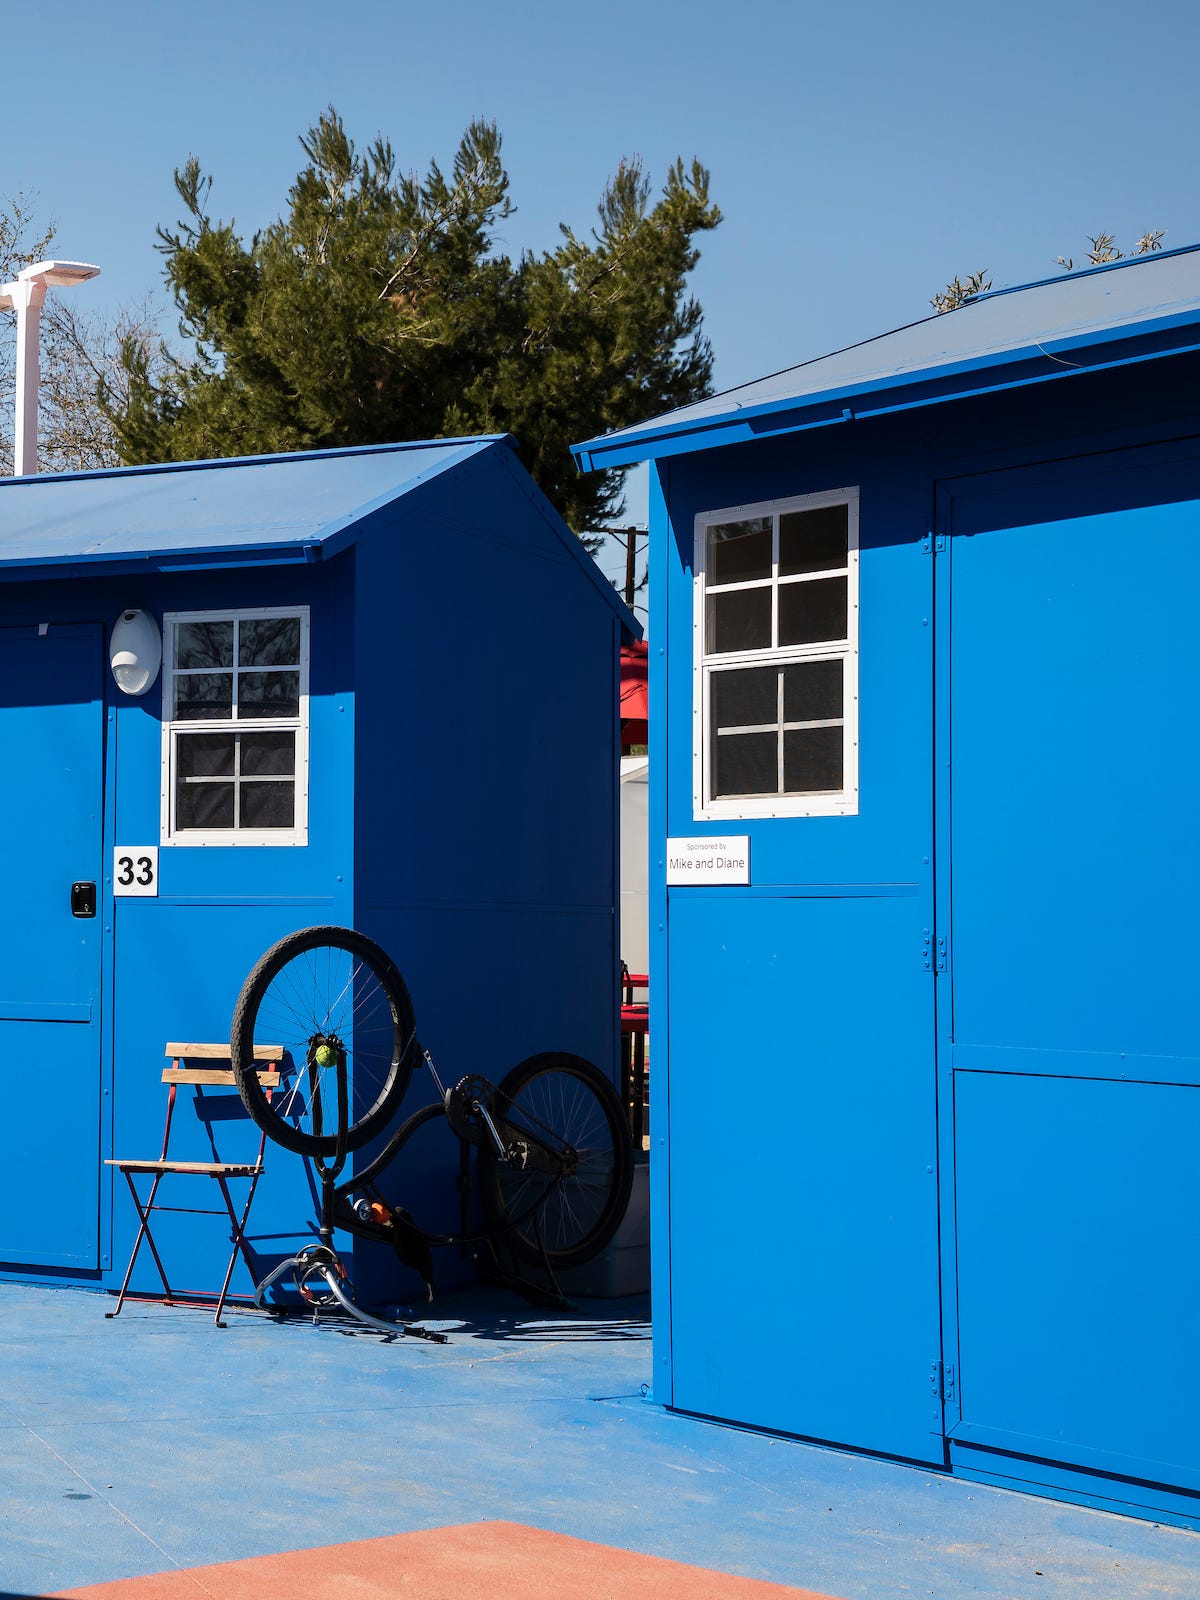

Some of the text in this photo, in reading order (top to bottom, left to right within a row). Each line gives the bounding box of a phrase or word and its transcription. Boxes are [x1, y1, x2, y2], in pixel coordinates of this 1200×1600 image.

[686, 842, 727, 851] Sponsored by
[669, 857, 745, 869] Mike and Diane
[117, 856, 154, 886] 33
